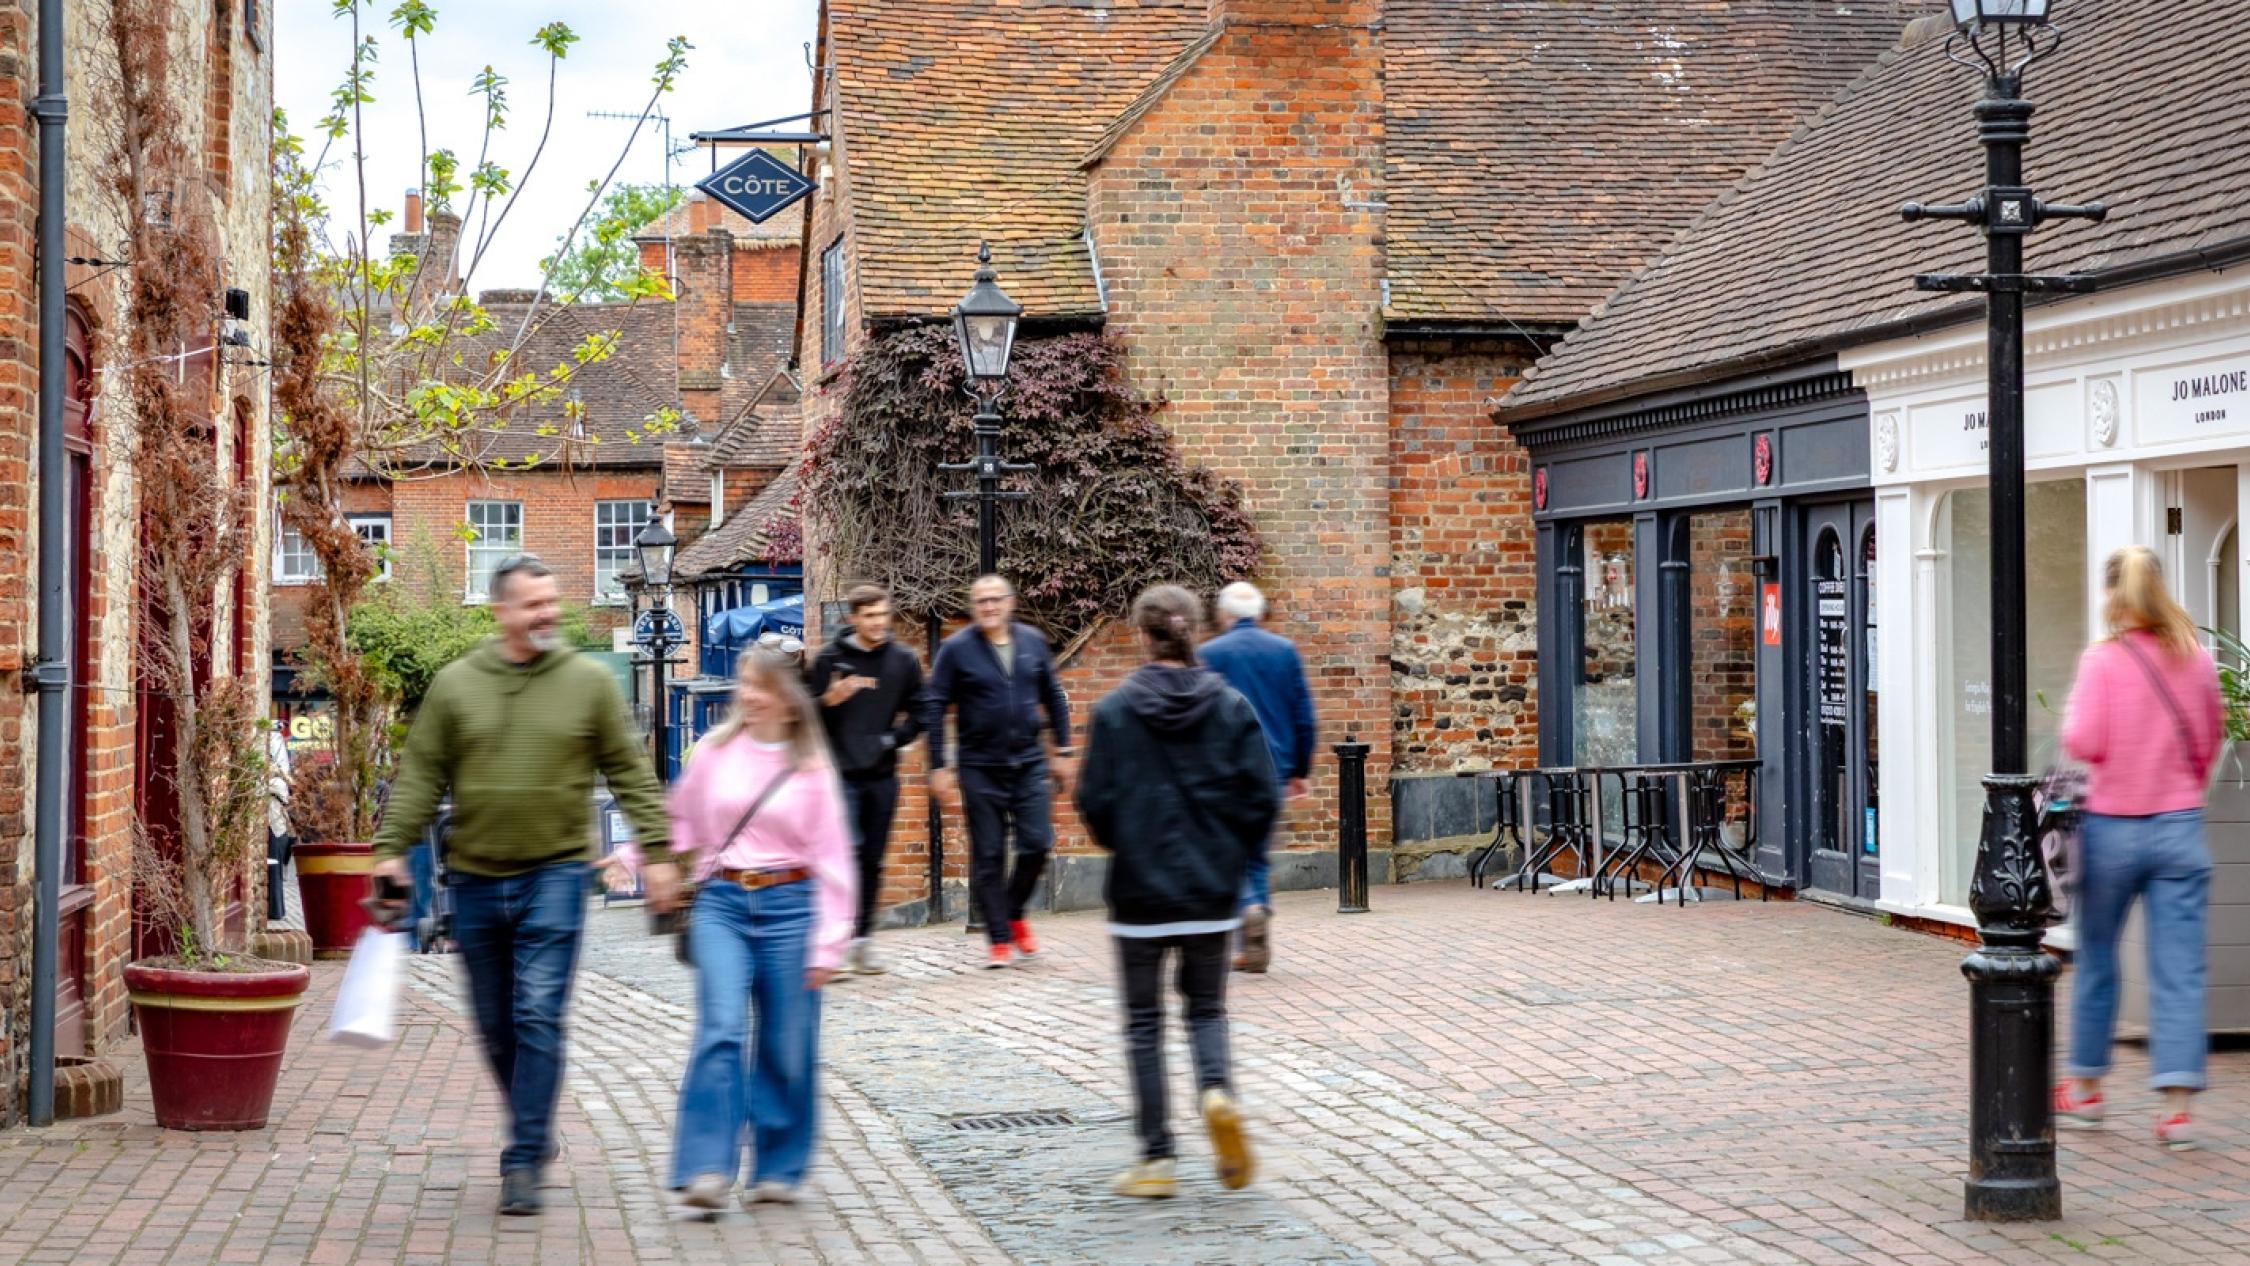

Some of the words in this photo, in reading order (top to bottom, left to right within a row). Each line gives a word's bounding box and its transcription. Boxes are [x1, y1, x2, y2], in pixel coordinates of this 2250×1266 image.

[724, 174, 790, 195] CÔTE
[2172, 380, 2188, 401] JO
[2190, 370, 2247, 398] MALONE
[1964, 413, 1976, 431] JO
[2195, 409, 2226, 423] LONDON
